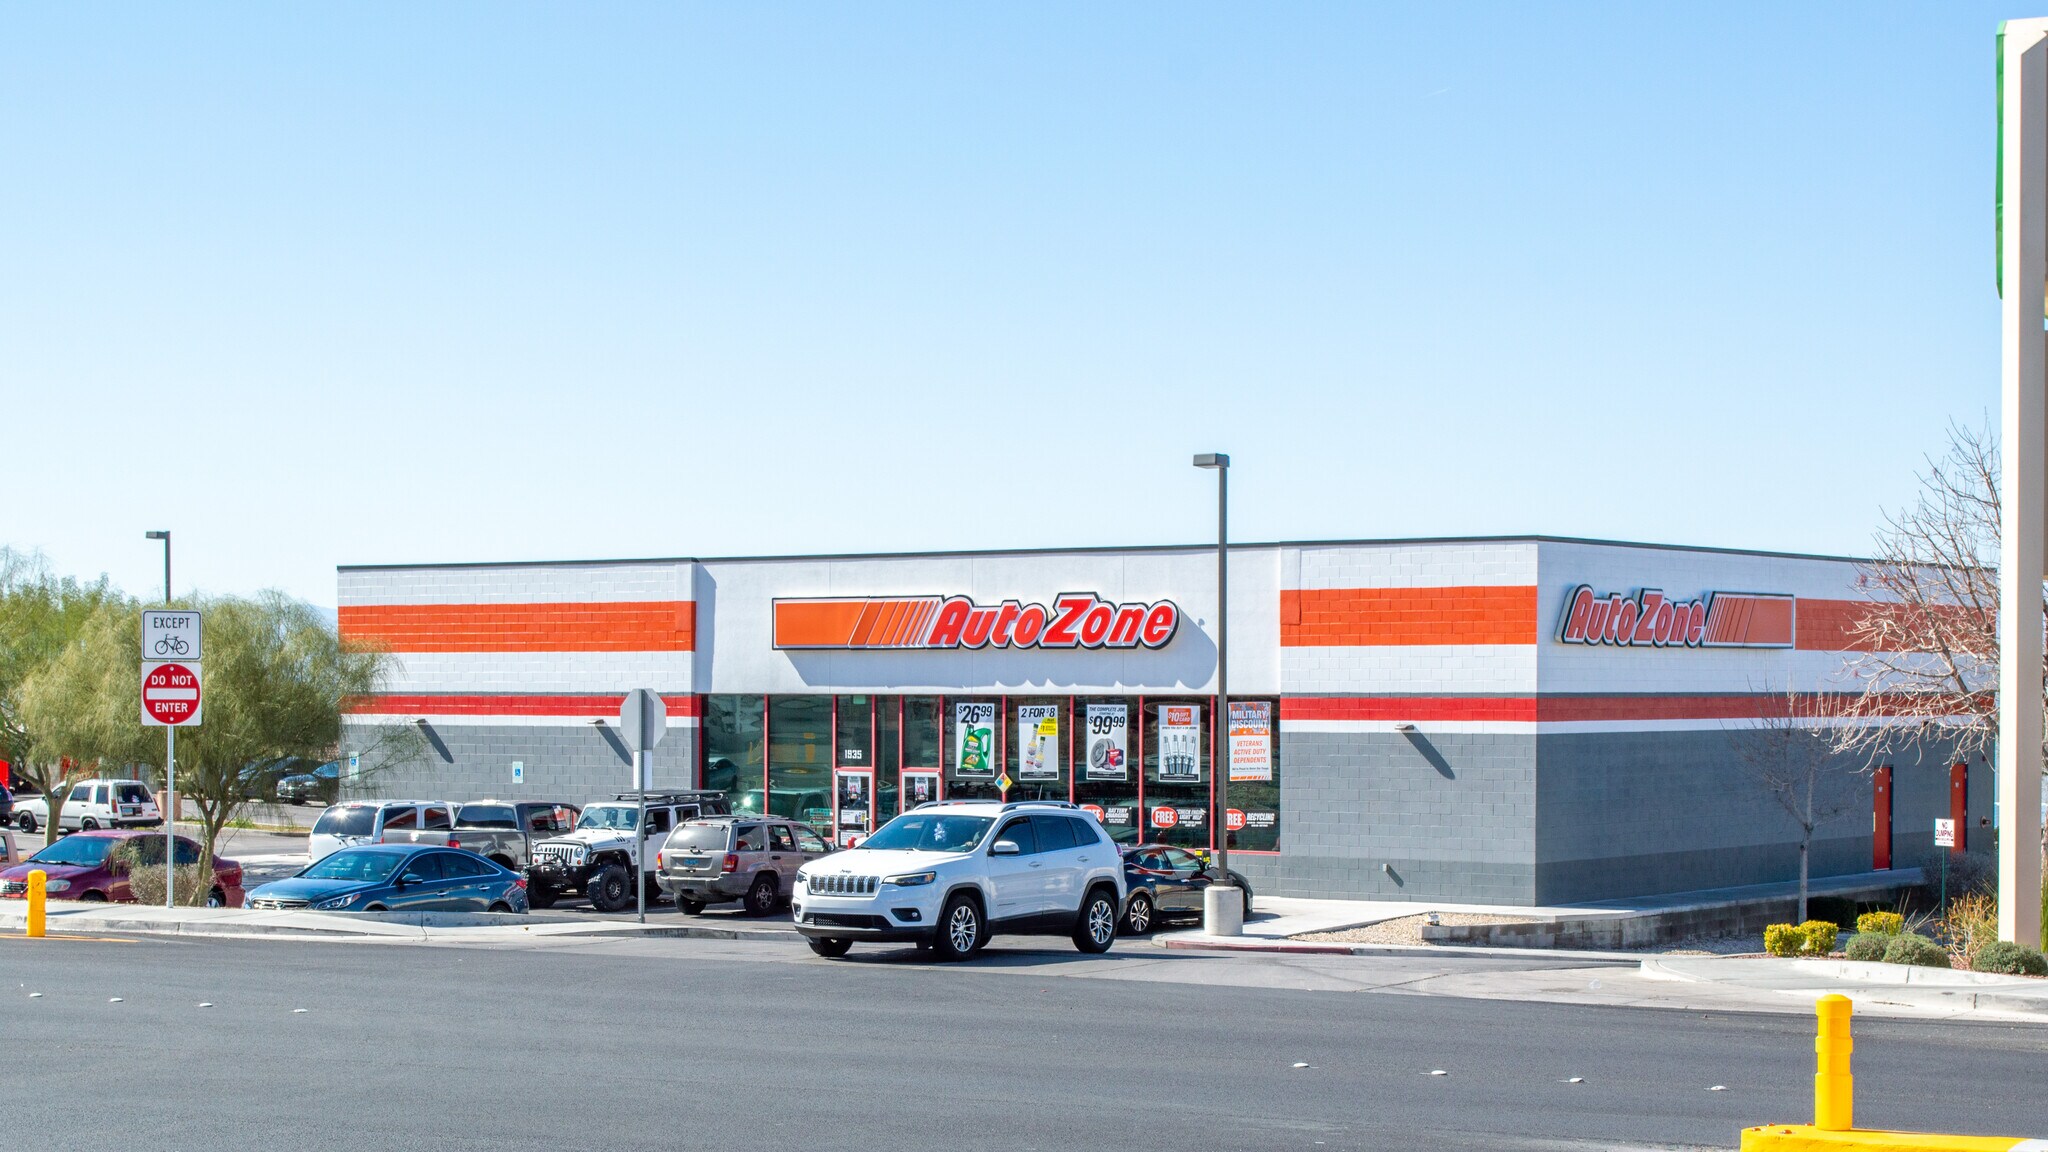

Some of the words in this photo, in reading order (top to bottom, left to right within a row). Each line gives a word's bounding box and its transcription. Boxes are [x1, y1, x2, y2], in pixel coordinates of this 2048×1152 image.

[924, 594, 1178, 648] AutoZone
[1564, 587, 1704, 645] AutoZone
[153, 617, 190, 629] EXCEPT
[151, 675, 166, 685] DO
[171, 675, 192, 685] NOT
[155, 702, 188, 713] ENTER
[1021, 707, 1028, 718] 2
[1028, 707, 1045, 718] FOR
[1168, 711, 1180, 722] $10
[1232, 710, 1268, 719] MILITARY
[1231, 719, 1268, 729] DISCOUNT
[844, 749, 862, 760] 1935
[1155, 810, 1174, 824] FREE
[1227, 813, 1242, 826] REE
[1246, 812, 1275, 821] RECYCLING
[1941, 821, 1948, 829] NO
